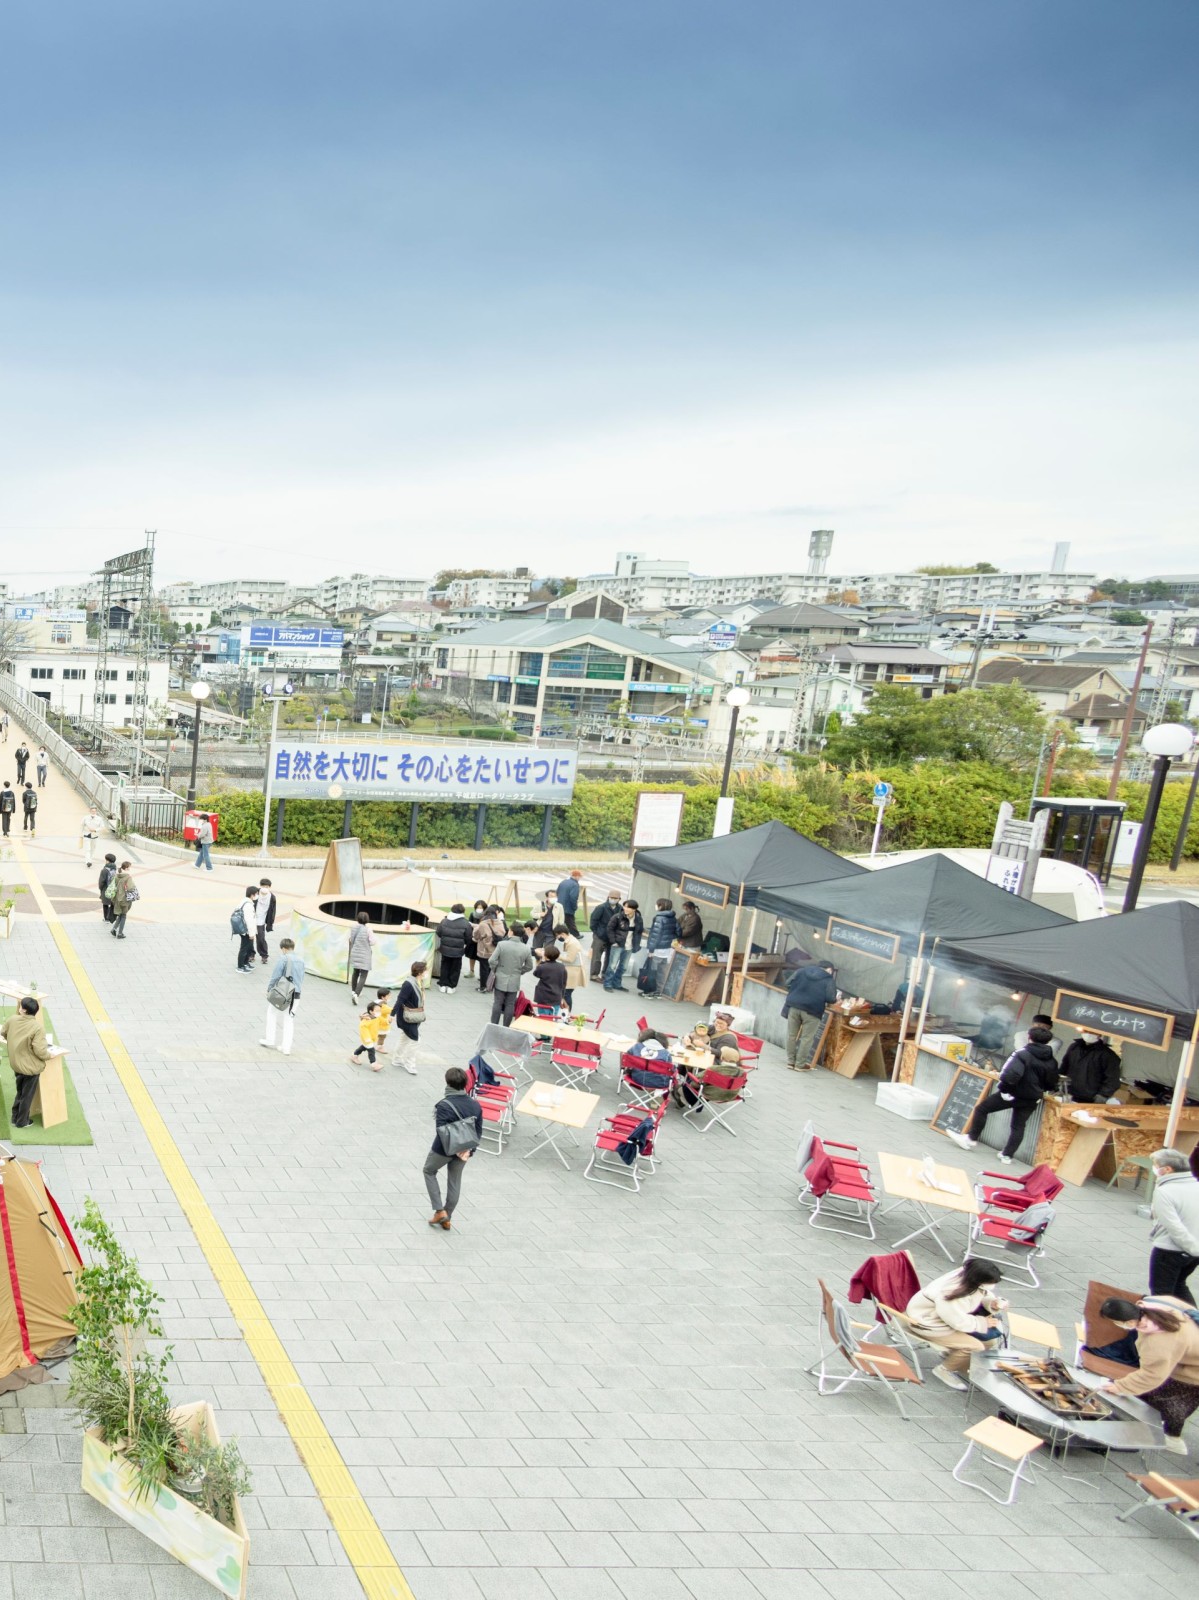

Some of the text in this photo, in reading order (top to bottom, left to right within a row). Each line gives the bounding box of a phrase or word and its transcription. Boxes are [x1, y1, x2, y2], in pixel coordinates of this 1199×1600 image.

[278, 632, 315, 641] アパマンショップ
[275, 749, 569, 784] 自然を大切に その心をたいせつに
[1100, 1010, 1146, 1032] とみや
